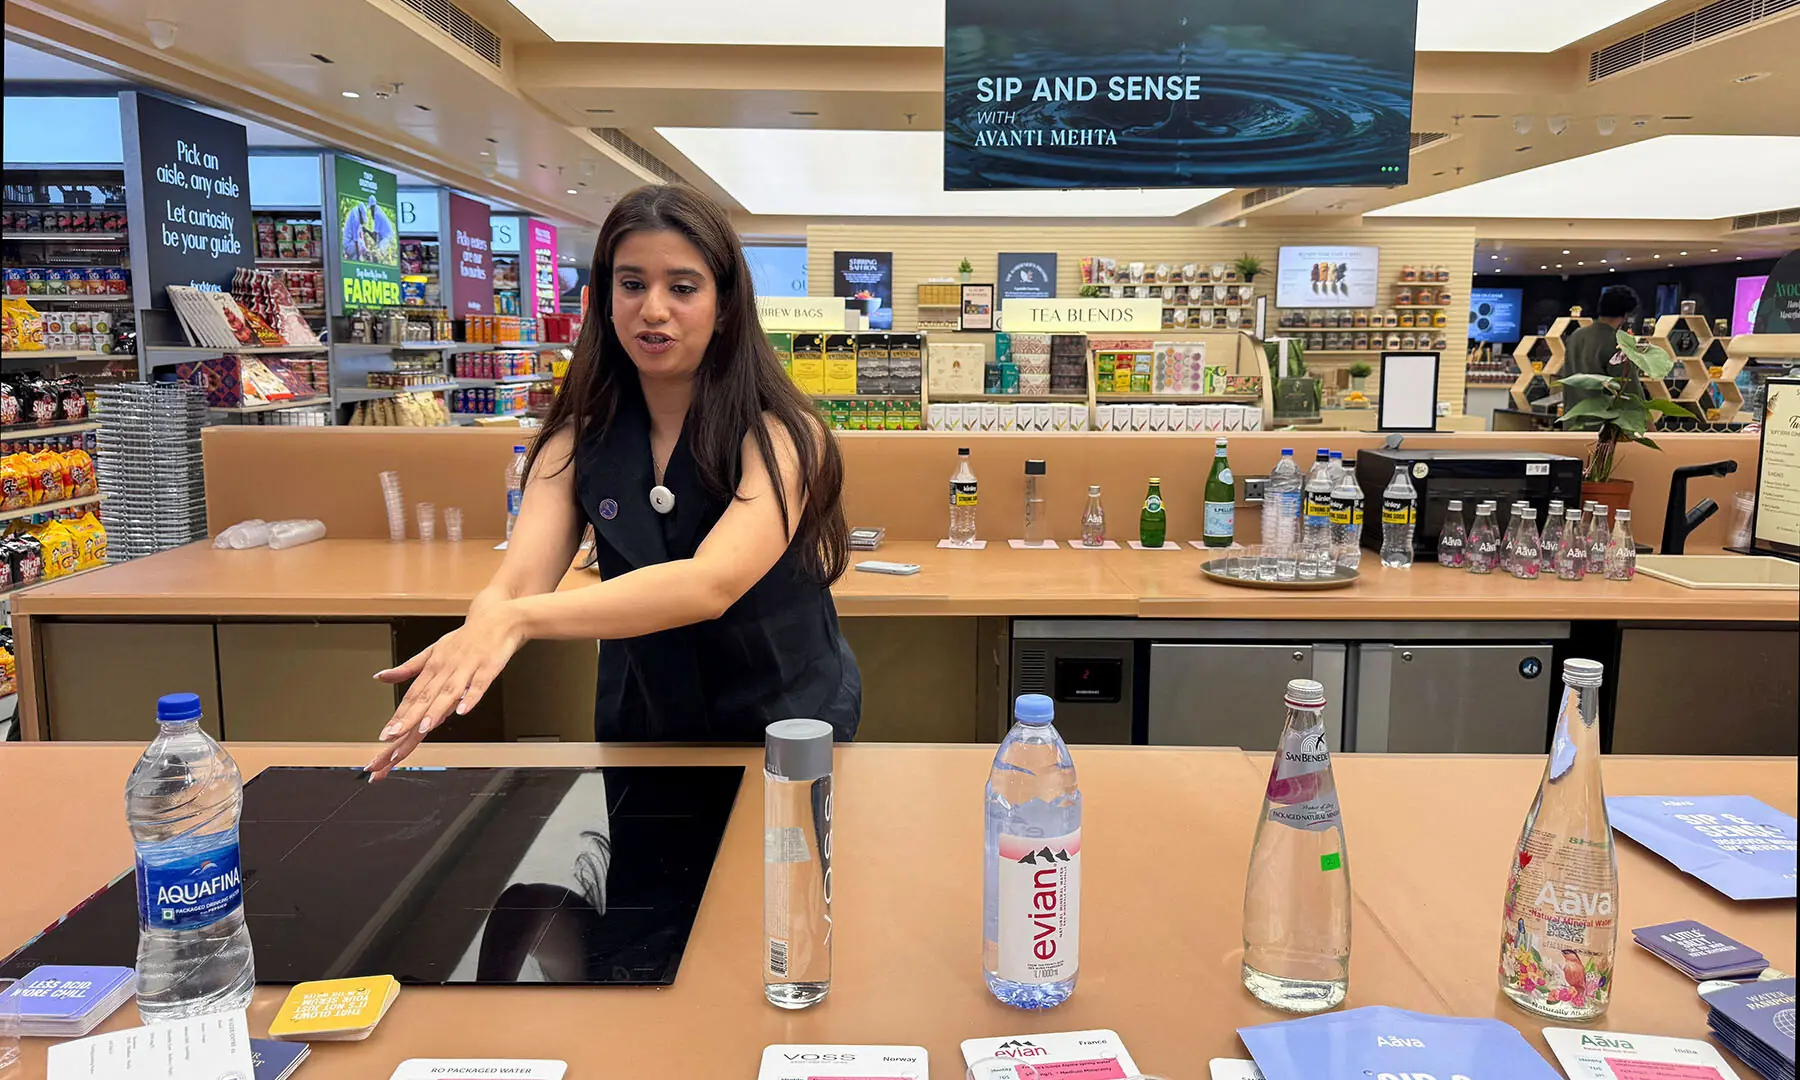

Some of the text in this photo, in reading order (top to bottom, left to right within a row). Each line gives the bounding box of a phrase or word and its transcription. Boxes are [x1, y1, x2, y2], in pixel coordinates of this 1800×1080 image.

[976, 75, 1200, 102] SIP AND SENSE
[976, 111, 1015, 125] WITH
[974, 128, 1117, 146] AVANTI MEHTA
[177, 140, 219, 170] Pick an
[157, 164, 239, 199] aisle, any aisle
[166, 200, 234, 233] Let curiosity
[162, 224, 241, 258] be your guide
[343, 277, 400, 305] FARMER
[761, 308, 823, 318] BREW BAGS
[1029, 308, 1134, 323] TEA BLENDS
[1285, 751, 1301, 761] SAN
[1273, 810, 1301, 820] PACKAGED
[1674, 813, 1754, 825] SIP &
[822, 792, 833, 946] VOSS
[157, 867, 240, 906] AQUAFINA
[175, 904, 206, 914] PACKAGED
[206, 896, 229, 909] DRINKING
[1027, 868, 1057, 960] evian
[1531, 910, 1560, 923] Natural
[1563, 917, 1594, 927] Mineral
[28, 980, 59, 990] LESS
[10, 988, 86, 998] MORE CHILL
[342, 994, 369, 1003] YOUR
[1745, 991, 1788, 1002] WATER
[294, 1005, 319, 1013] JUST
[323, 1003, 344, 1011] NOT
[334, 1008, 362, 1017] THAT
[1531, 1001, 1569, 1015] Naturally
[783, 1053, 856, 1061] VOSS
[994, 1047, 1047, 1058] evian
